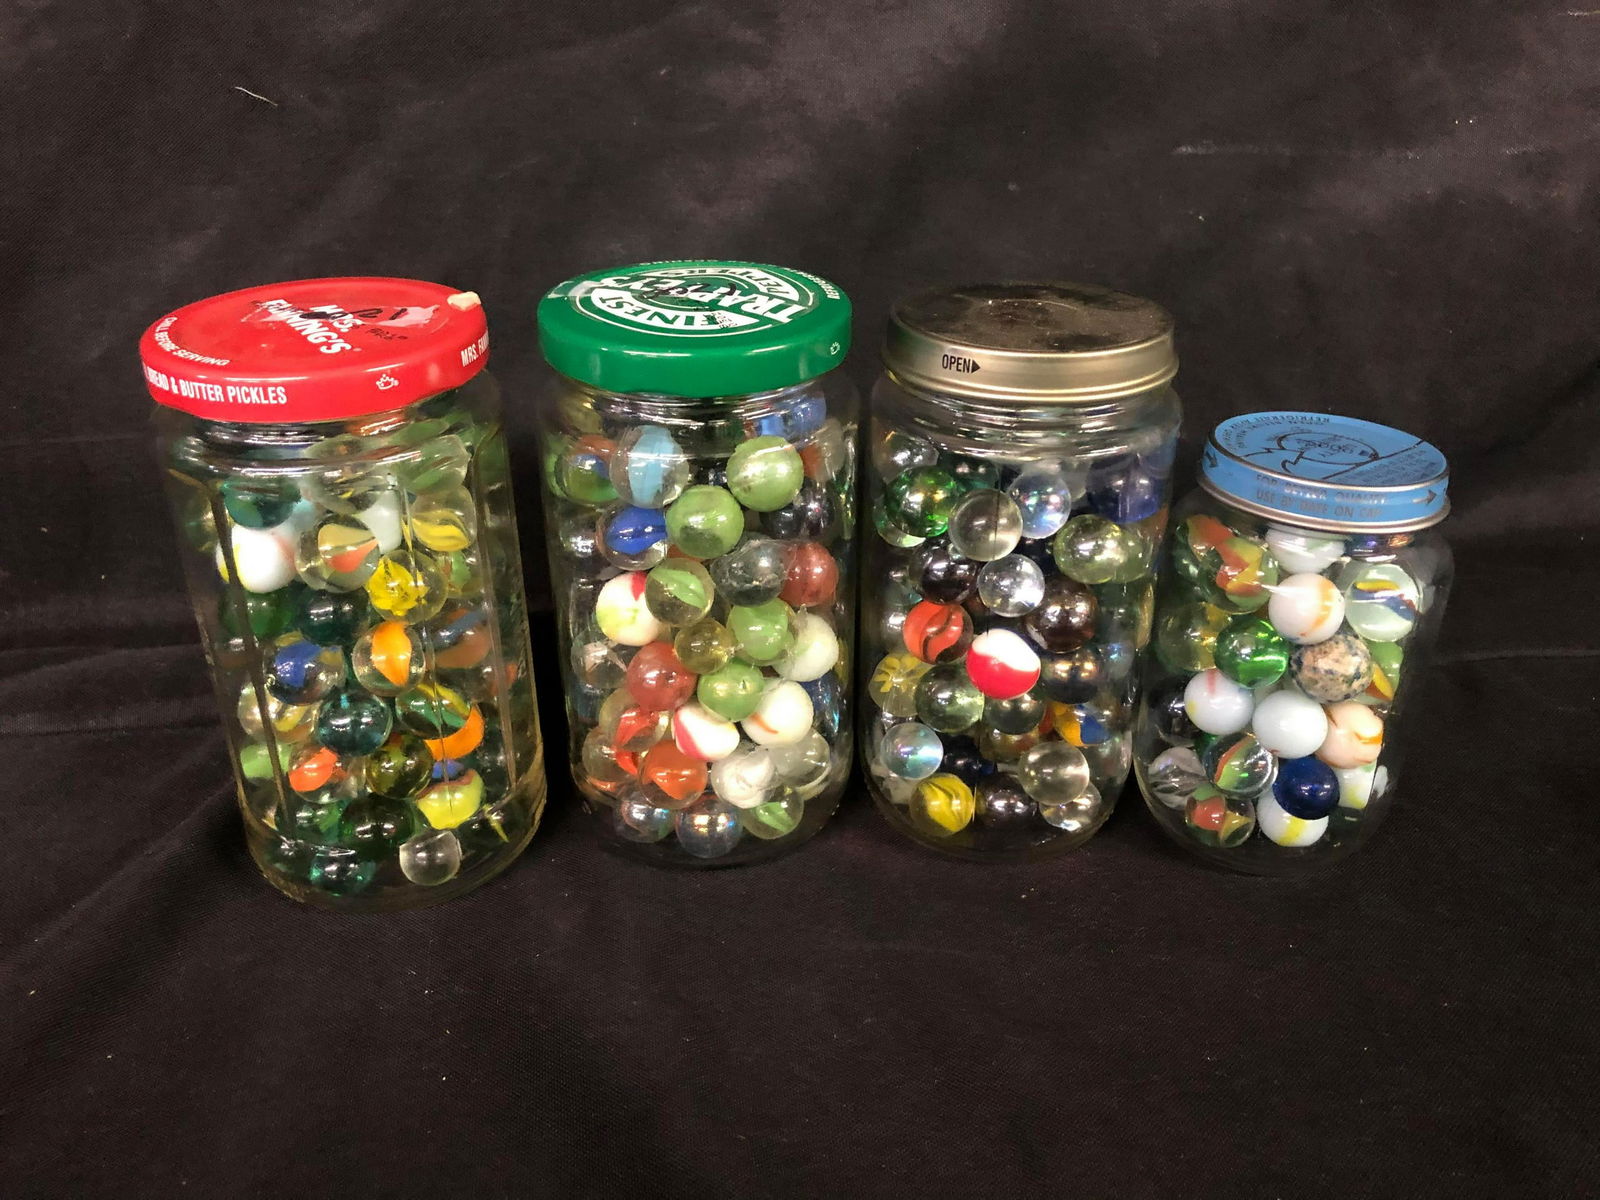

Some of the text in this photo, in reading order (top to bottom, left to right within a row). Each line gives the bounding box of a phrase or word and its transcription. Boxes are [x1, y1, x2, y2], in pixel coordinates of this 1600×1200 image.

[155, 316, 178, 333] CHILL
[172, 349, 231, 366] SERVING
[942, 354, 971, 373] OPEN
[170, 377, 179, 394] &
[179, 379, 225, 403] BUTTER
[226, 386, 288, 404] PICKLES
[1257, 474, 1278, 486] FOR
[1257, 489, 1276, 504] USE
[1334, 505, 1354, 518] ON
